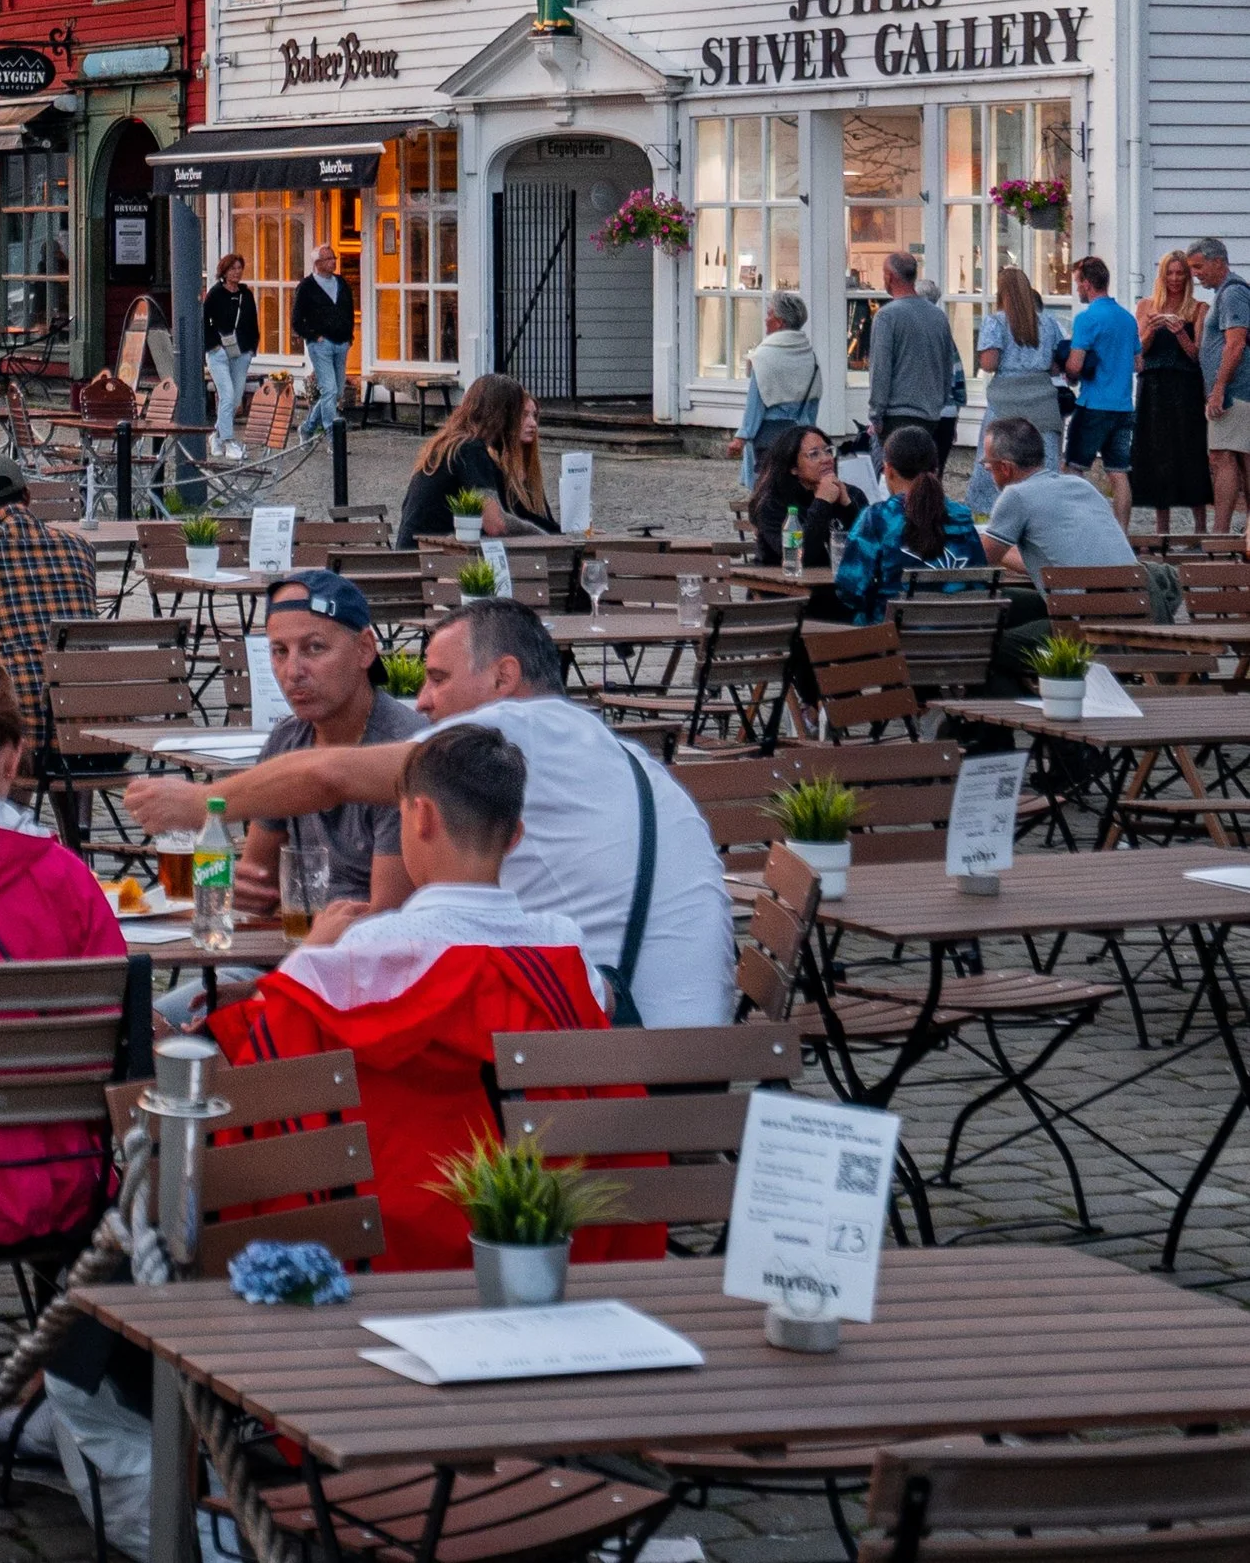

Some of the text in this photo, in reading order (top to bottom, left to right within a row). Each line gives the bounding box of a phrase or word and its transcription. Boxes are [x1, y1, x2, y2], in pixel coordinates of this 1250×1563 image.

[699, 6, 1089, 87] SILVER GALLERY
[114, 204, 148, 213] BRYGGEN
[194, 859, 226, 886] Sprite
[828, 1222, 866, 1254] 13
